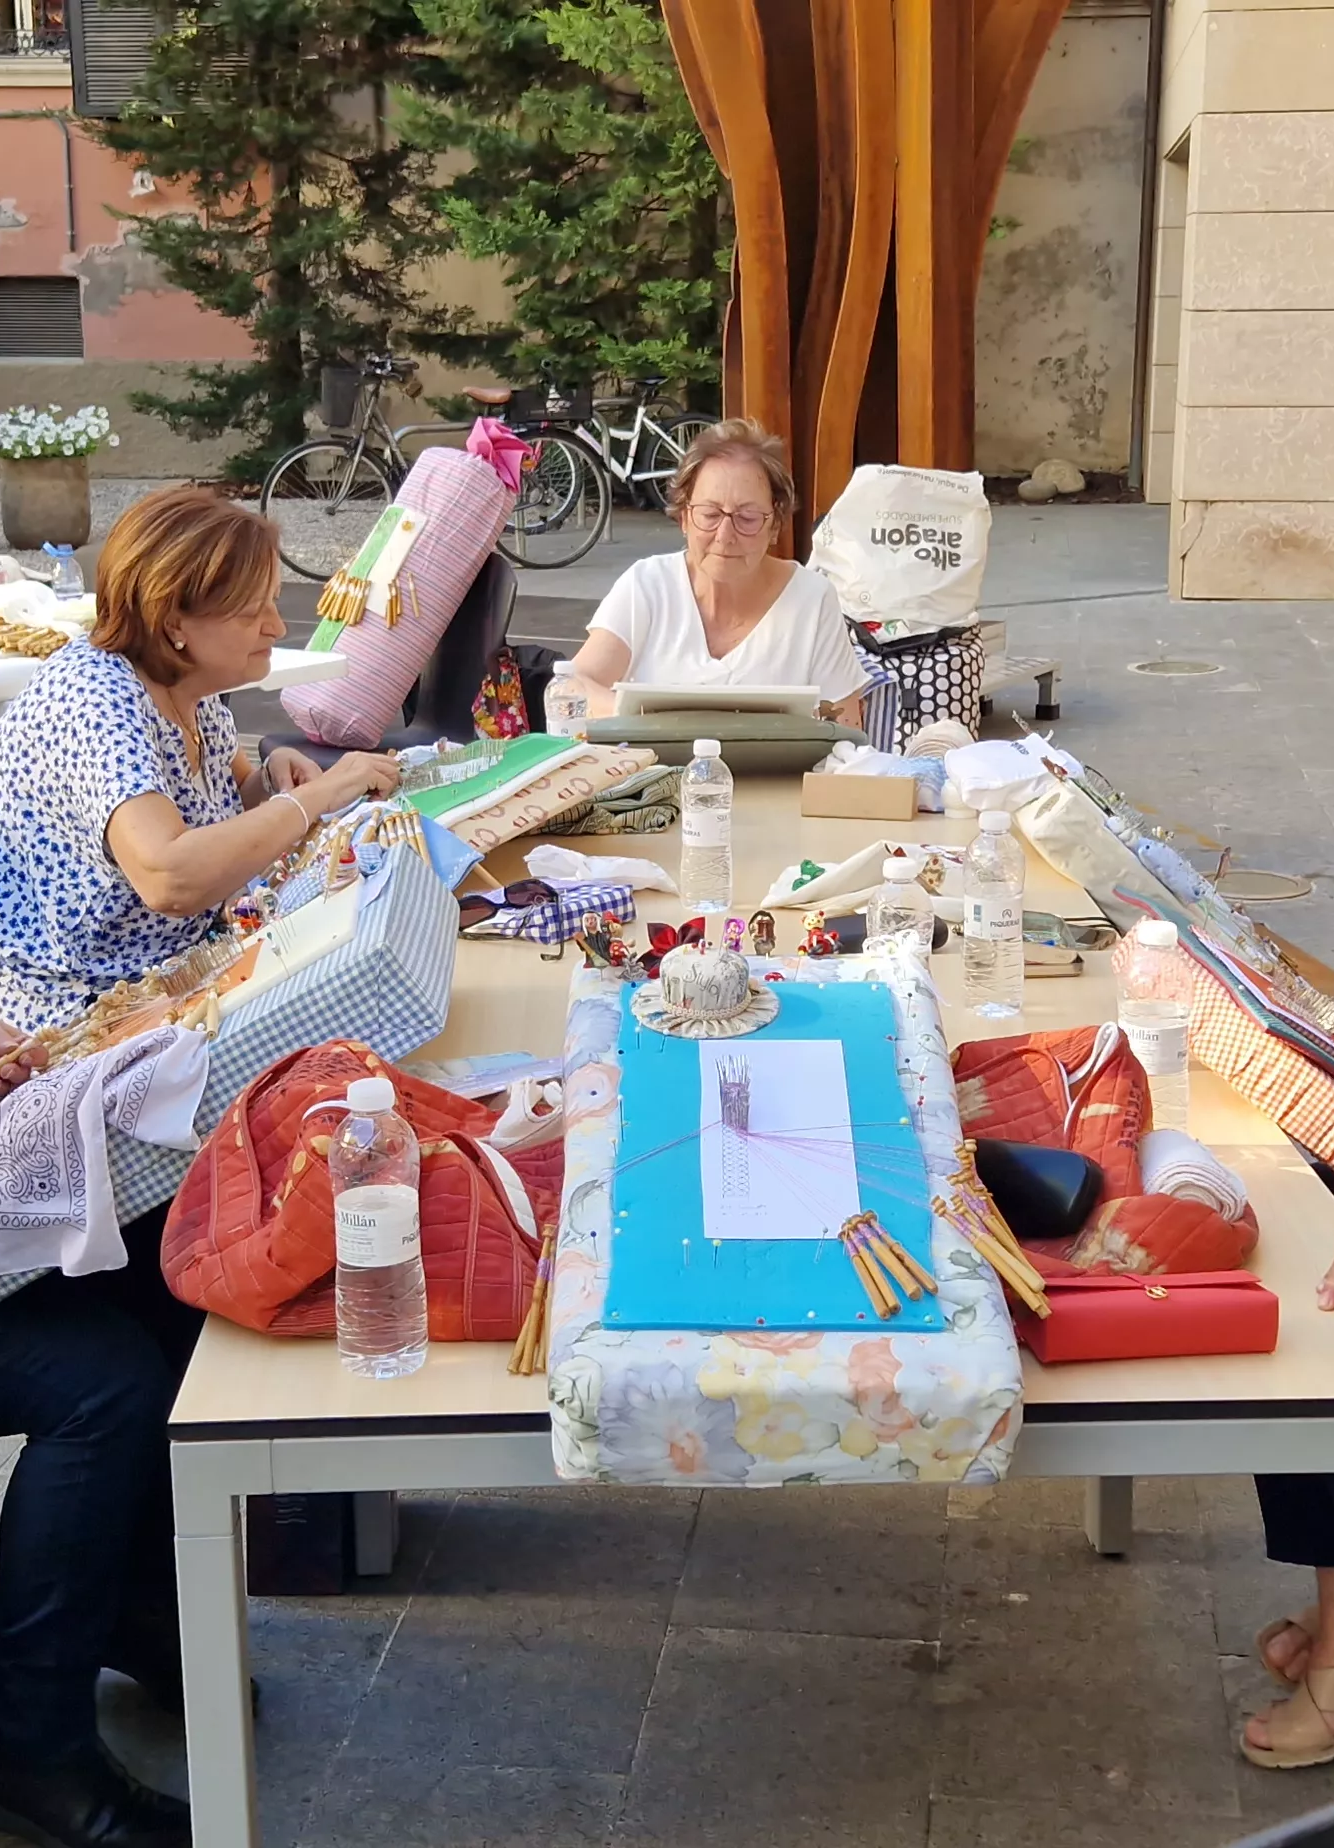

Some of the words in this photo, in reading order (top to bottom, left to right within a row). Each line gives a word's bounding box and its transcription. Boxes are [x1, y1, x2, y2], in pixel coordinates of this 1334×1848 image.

[875, 510, 962, 525] SUPERMERCADOS
[913, 547, 962, 572] alto
[340, 1211, 377, 1227] Millán
